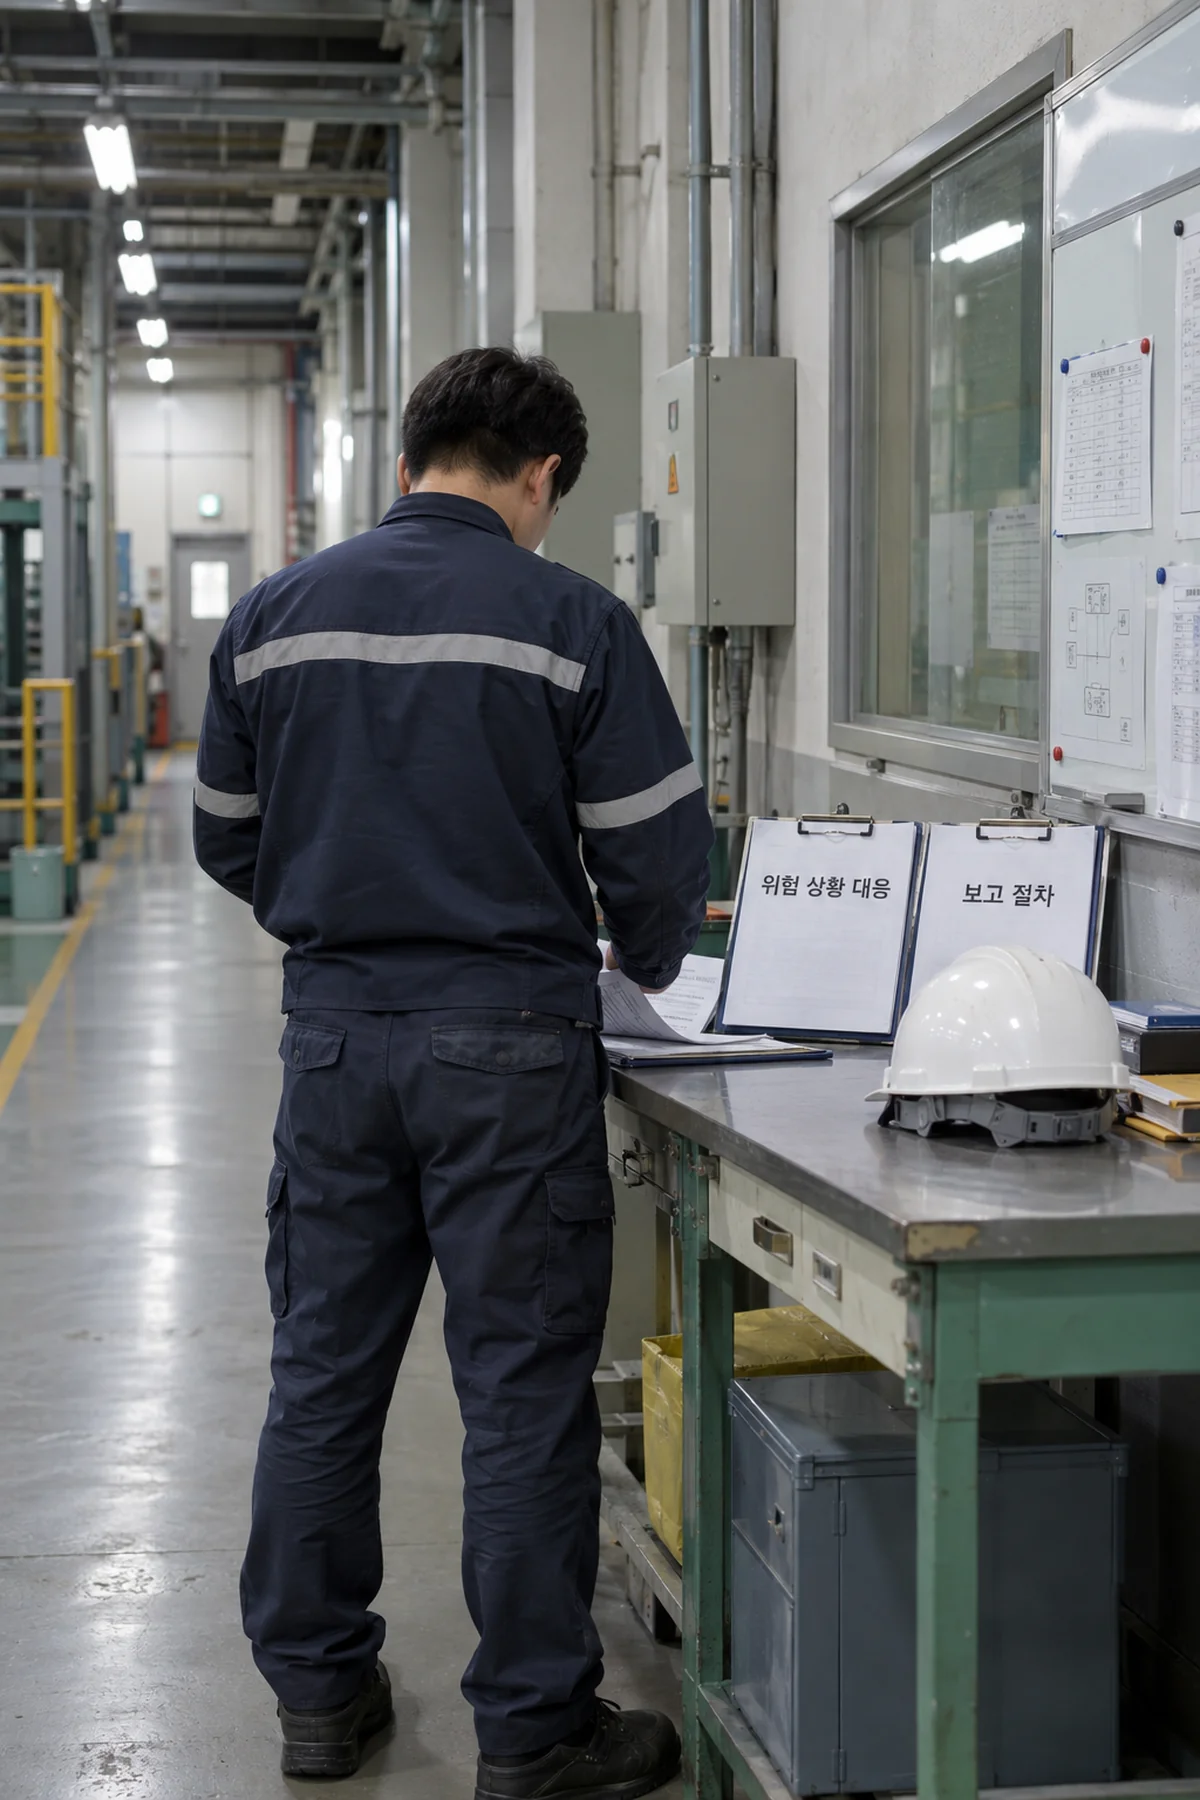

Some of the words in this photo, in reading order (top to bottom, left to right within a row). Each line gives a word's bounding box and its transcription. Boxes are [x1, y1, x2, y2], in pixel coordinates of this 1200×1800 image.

[761, 874, 800, 897] 위험
[806, 876, 846, 899] 상황
[851, 877, 891, 900] 대응
[961, 883, 1004, 904] 보고
[1012, 883, 1056, 908] 절차
